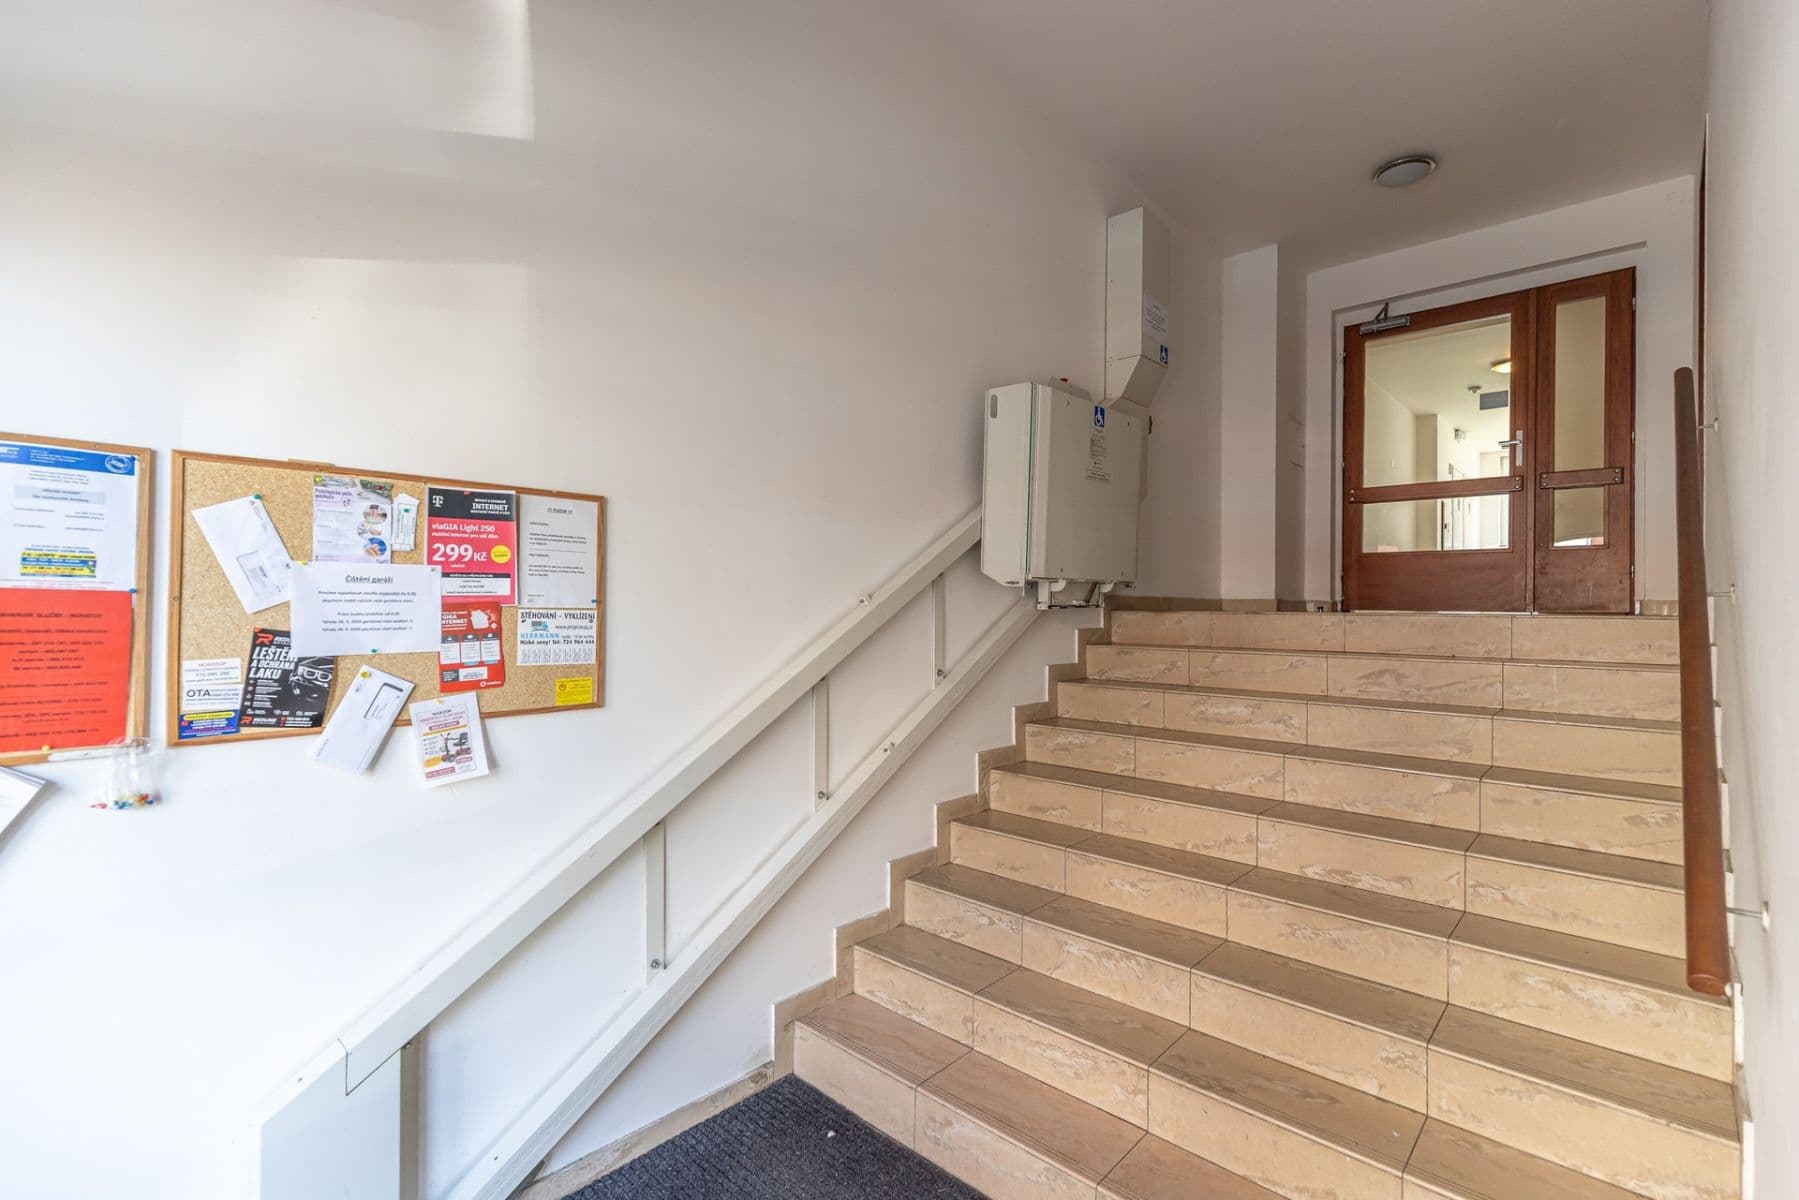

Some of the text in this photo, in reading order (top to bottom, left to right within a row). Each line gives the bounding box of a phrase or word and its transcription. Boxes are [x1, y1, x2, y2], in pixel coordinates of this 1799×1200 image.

[472, 503, 510, 511] INTERNET
[460, 524, 480, 534] Light
[432, 543, 474, 562] 299
[474, 551, 488, 562] Kč
[345, 574, 370, 584] Čištění
[520, 611, 557, 620] STĚHOVÁNÍ
[564, 612, 596, 620] VYKLÍZENÍ
[258, 660, 296, 670] OCHRANA
[249, 668, 282, 679] LAKU
[186, 688, 211, 698] OTA
